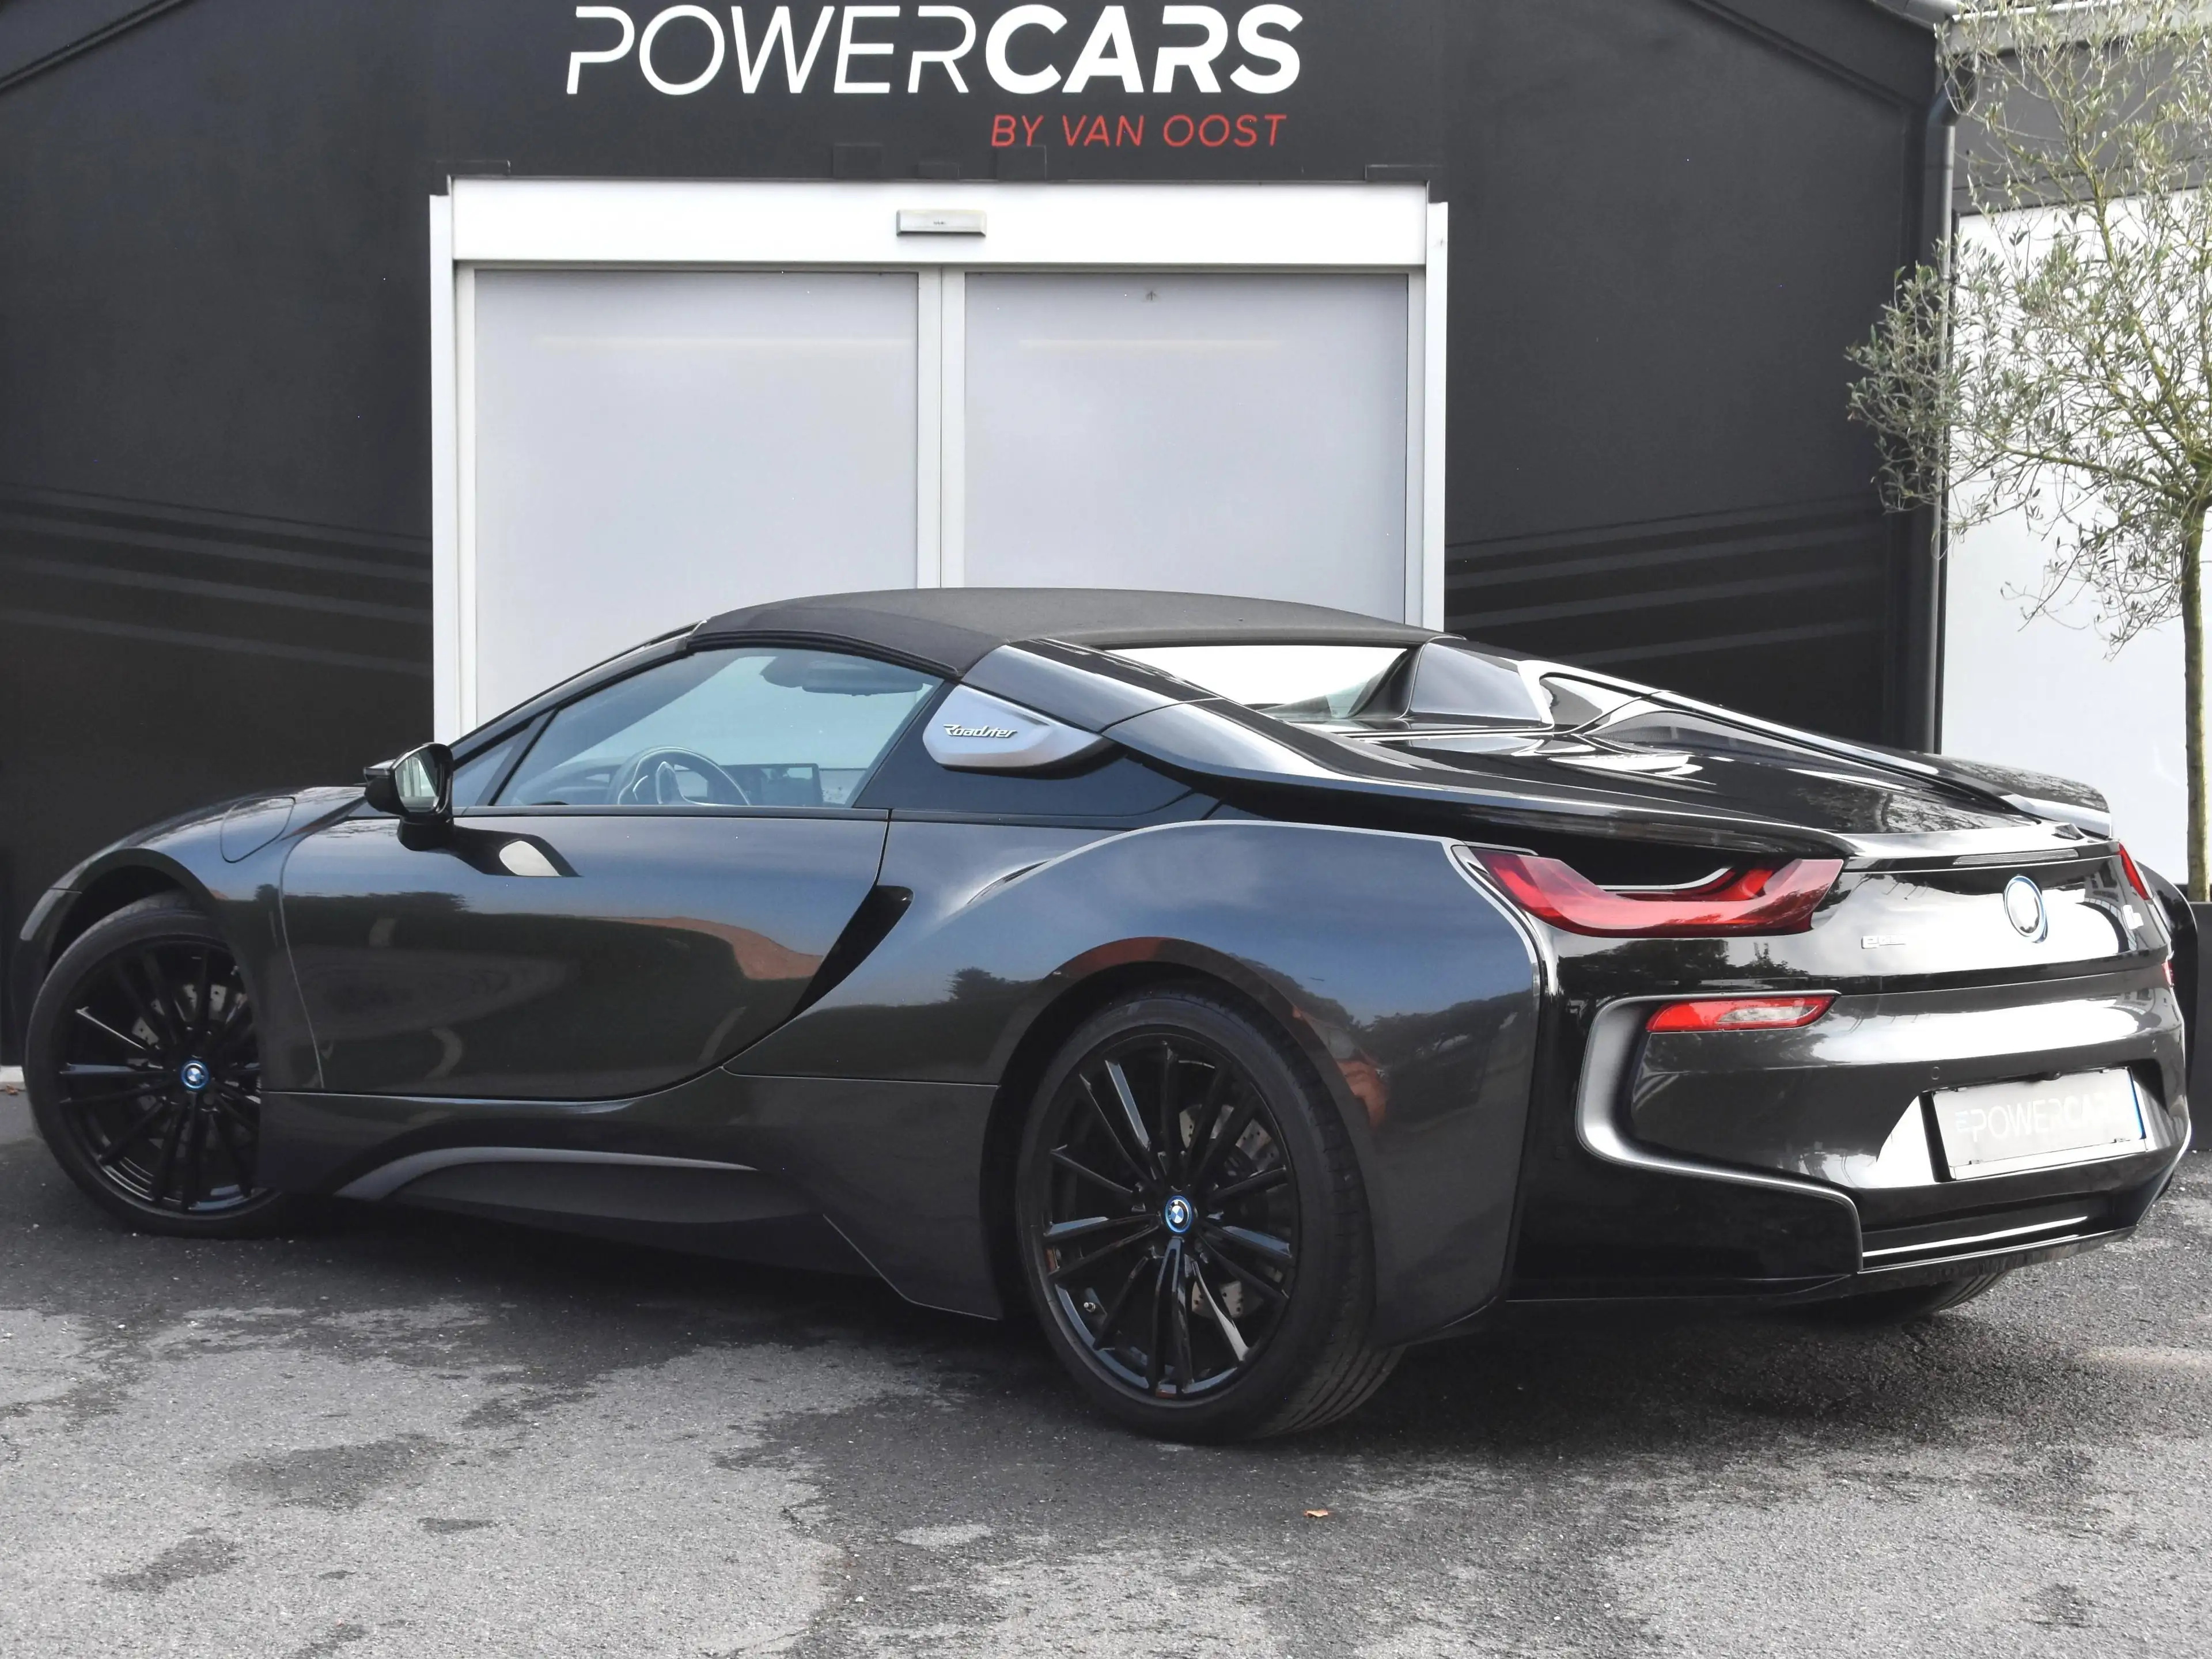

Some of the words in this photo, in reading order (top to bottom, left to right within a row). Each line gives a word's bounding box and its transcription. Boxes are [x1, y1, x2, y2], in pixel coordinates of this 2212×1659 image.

[566, 3, 1303, 95] POWERCARS
[991, 115, 1044, 146] BY
[1062, 115, 1144, 146] VAN
[1163, 114, 1287, 147] OOST
[943, 724, 1018, 738] Roadster
